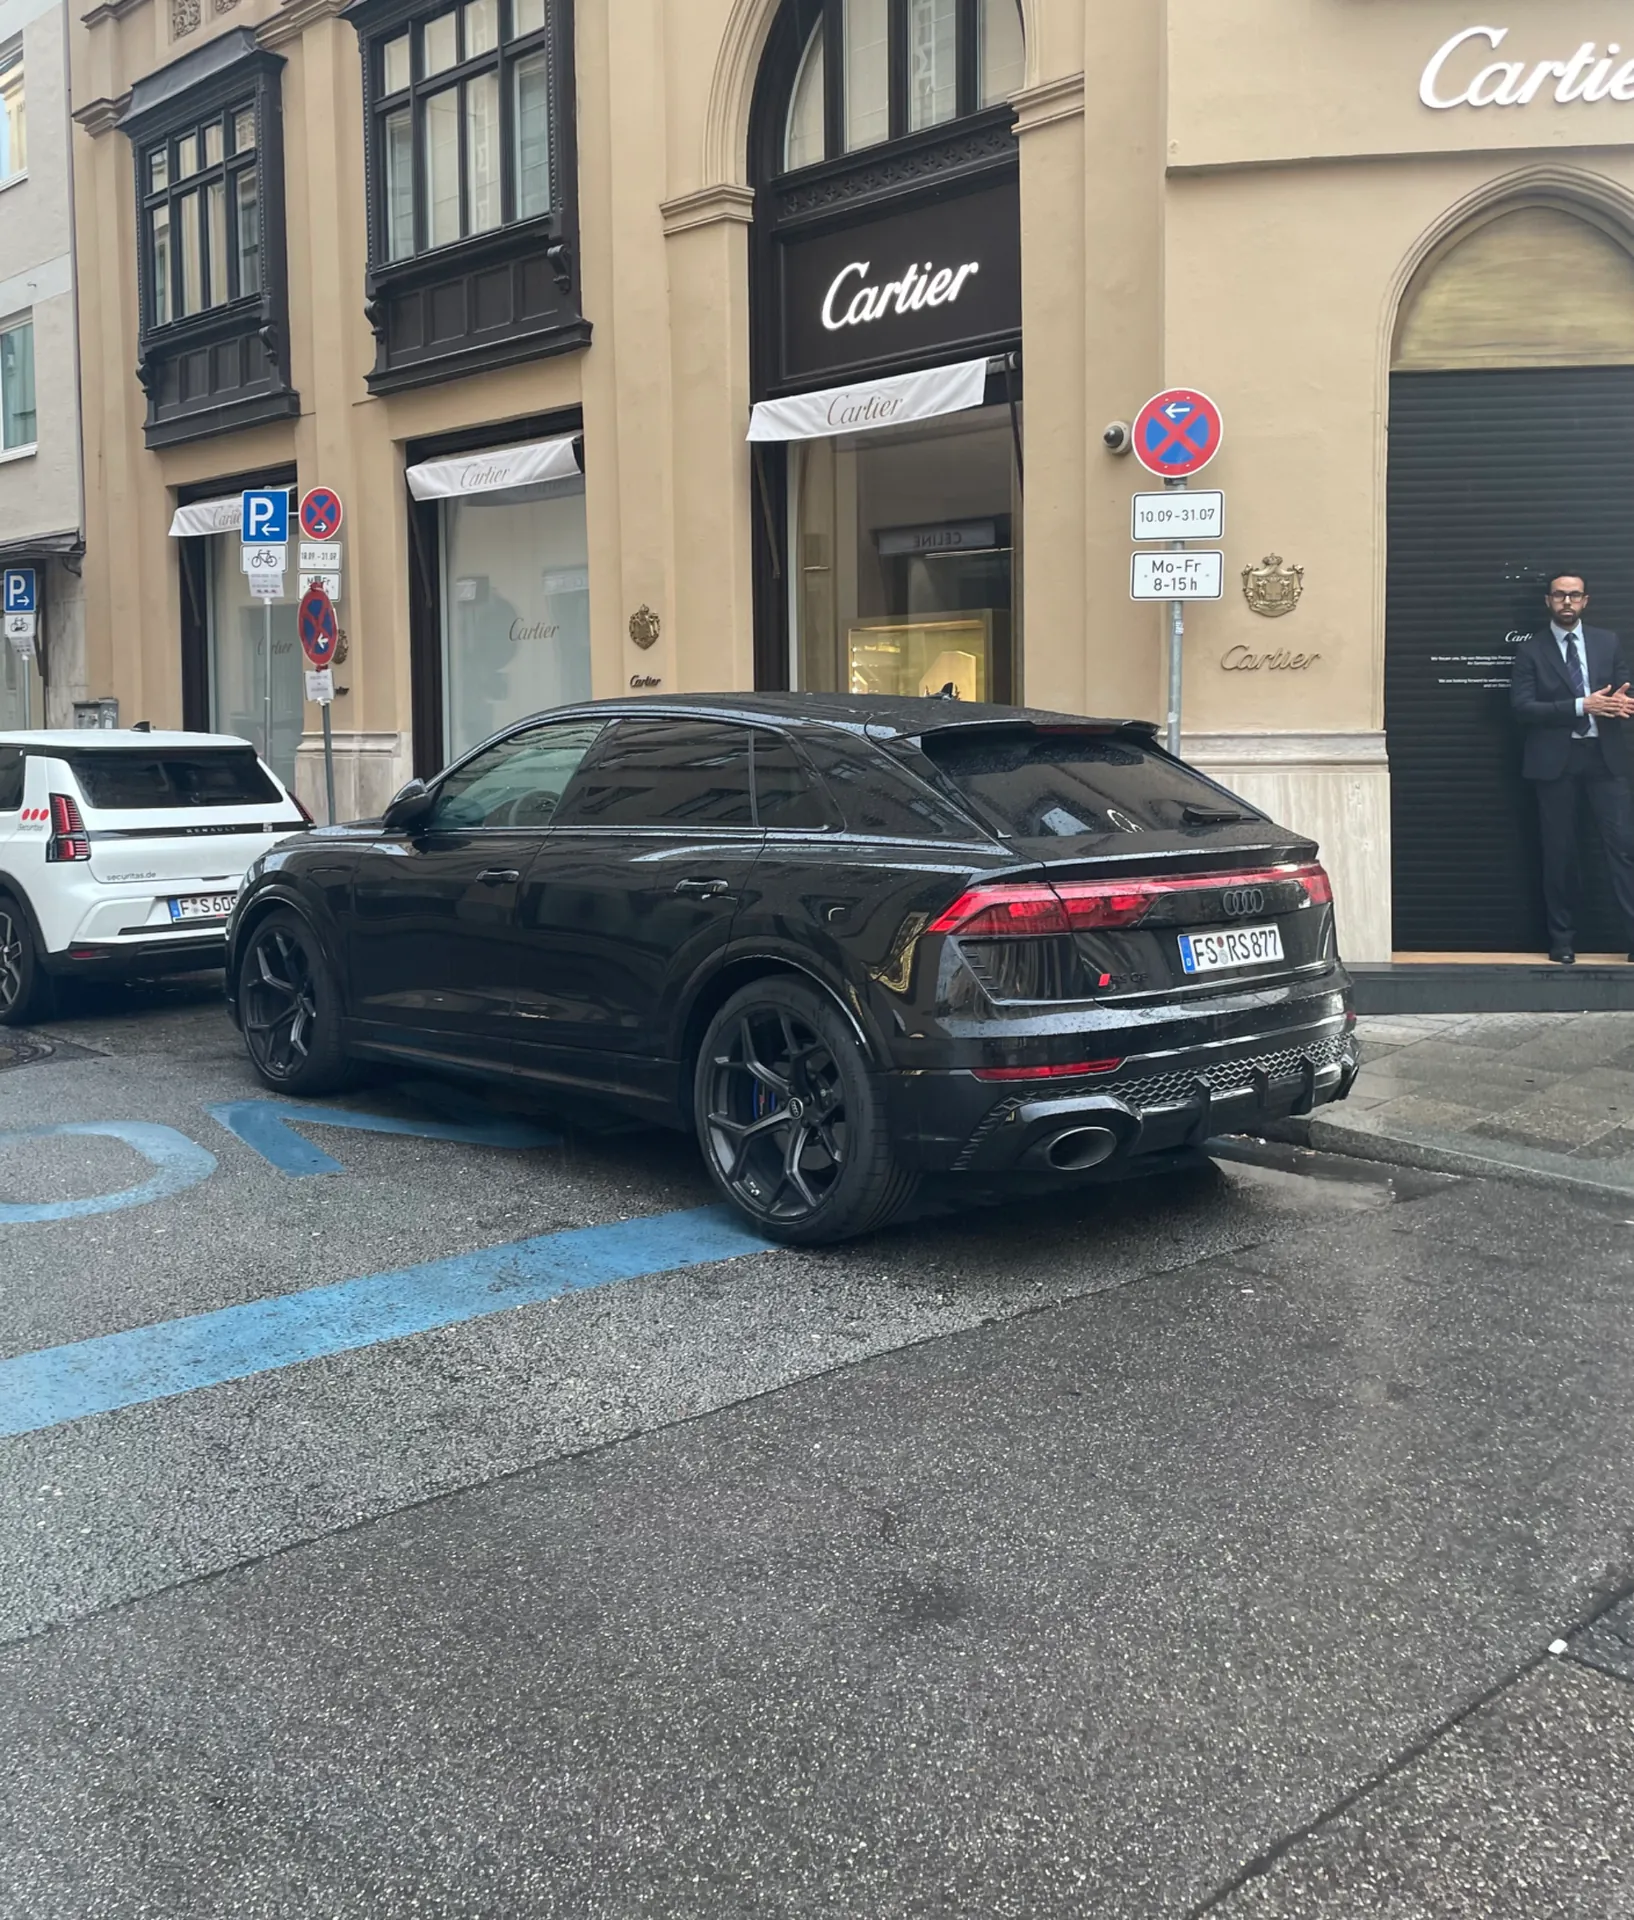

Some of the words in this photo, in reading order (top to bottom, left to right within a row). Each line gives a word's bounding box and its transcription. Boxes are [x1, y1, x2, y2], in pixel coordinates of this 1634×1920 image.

[821, 261, 979, 331] Cartier
[827, 393, 903, 427] Cartier
[460, 463, 510, 489] Cartier
[1139, 508, 1215, 523] 10.09-31.07
[1151, 559, 1201, 574] Mo-Fr
[509, 617, 559, 641] Cartier
[257, 636, 293, 656] Crtier
[1220, 644, 1321, 671] Cartier
[629, 674, 662, 688] Cartier
[106, 870, 157, 881] securitas.de
